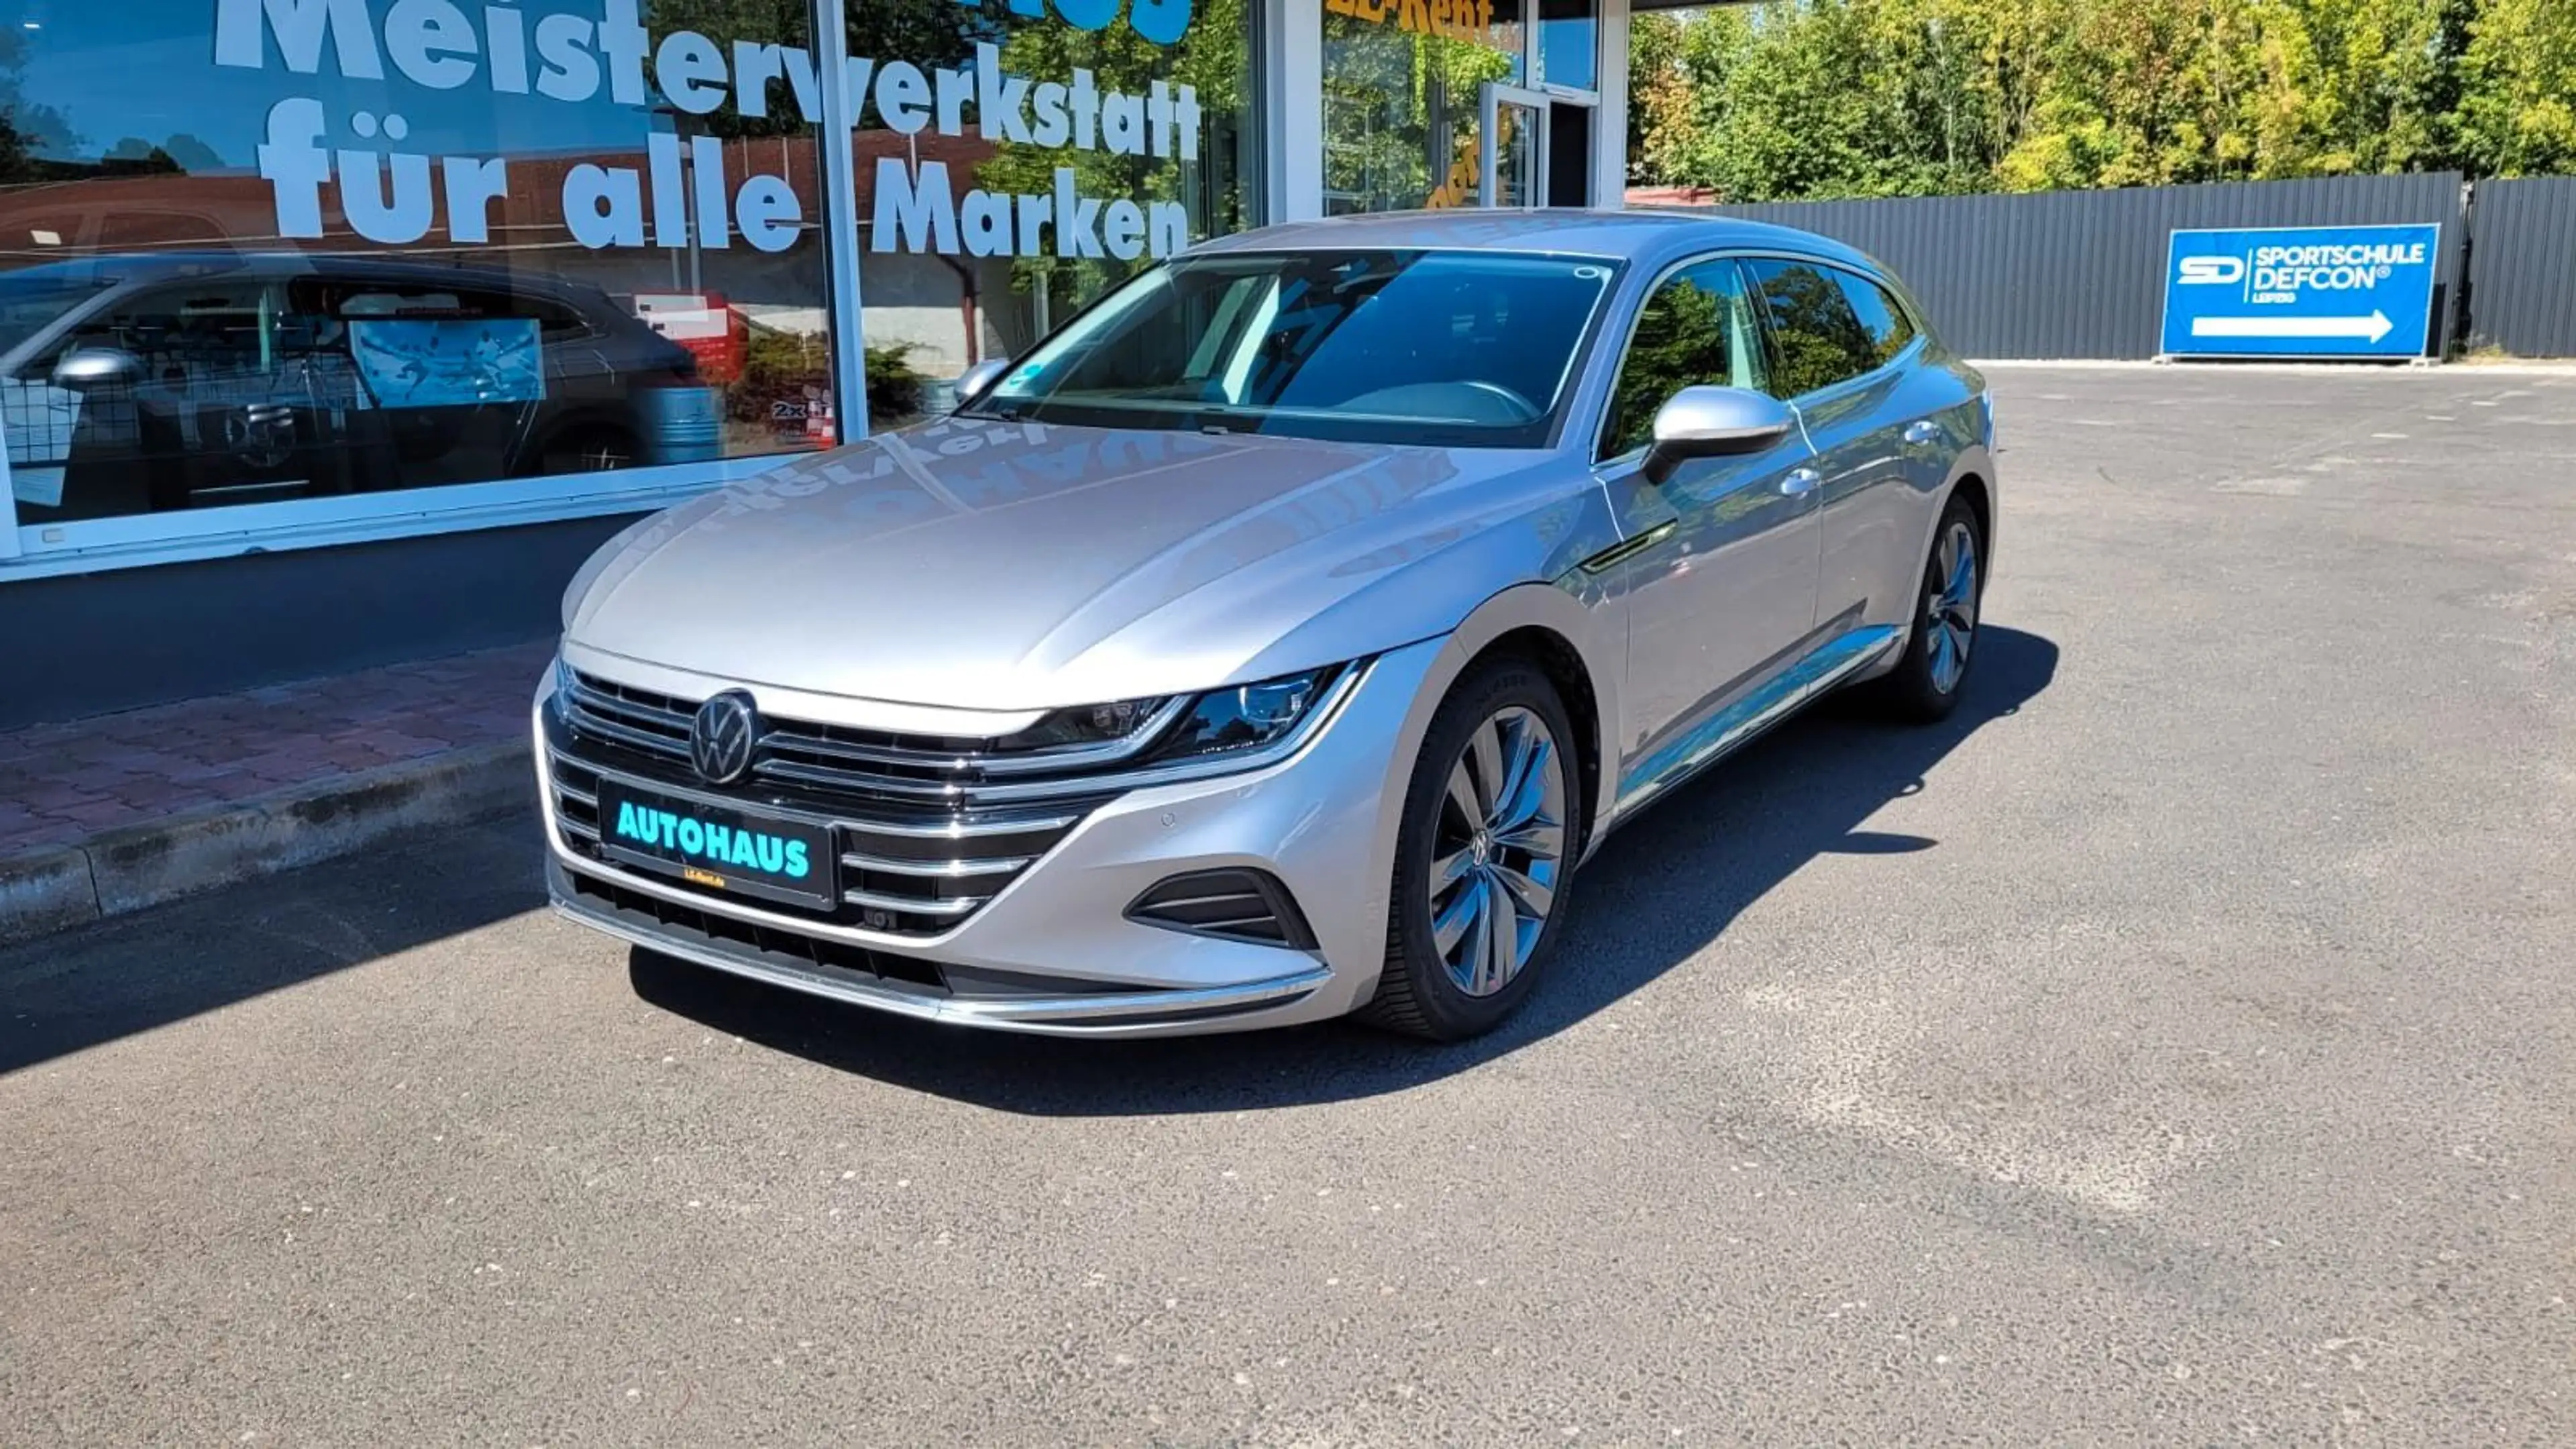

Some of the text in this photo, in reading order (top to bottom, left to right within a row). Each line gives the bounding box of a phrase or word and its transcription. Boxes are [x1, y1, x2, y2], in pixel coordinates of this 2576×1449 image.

[258, 97, 1188, 260] für alle Marken
[2256, 244, 2425, 266] SPORTSCHULE
[616, 800, 810, 877] AUTOHAUS
